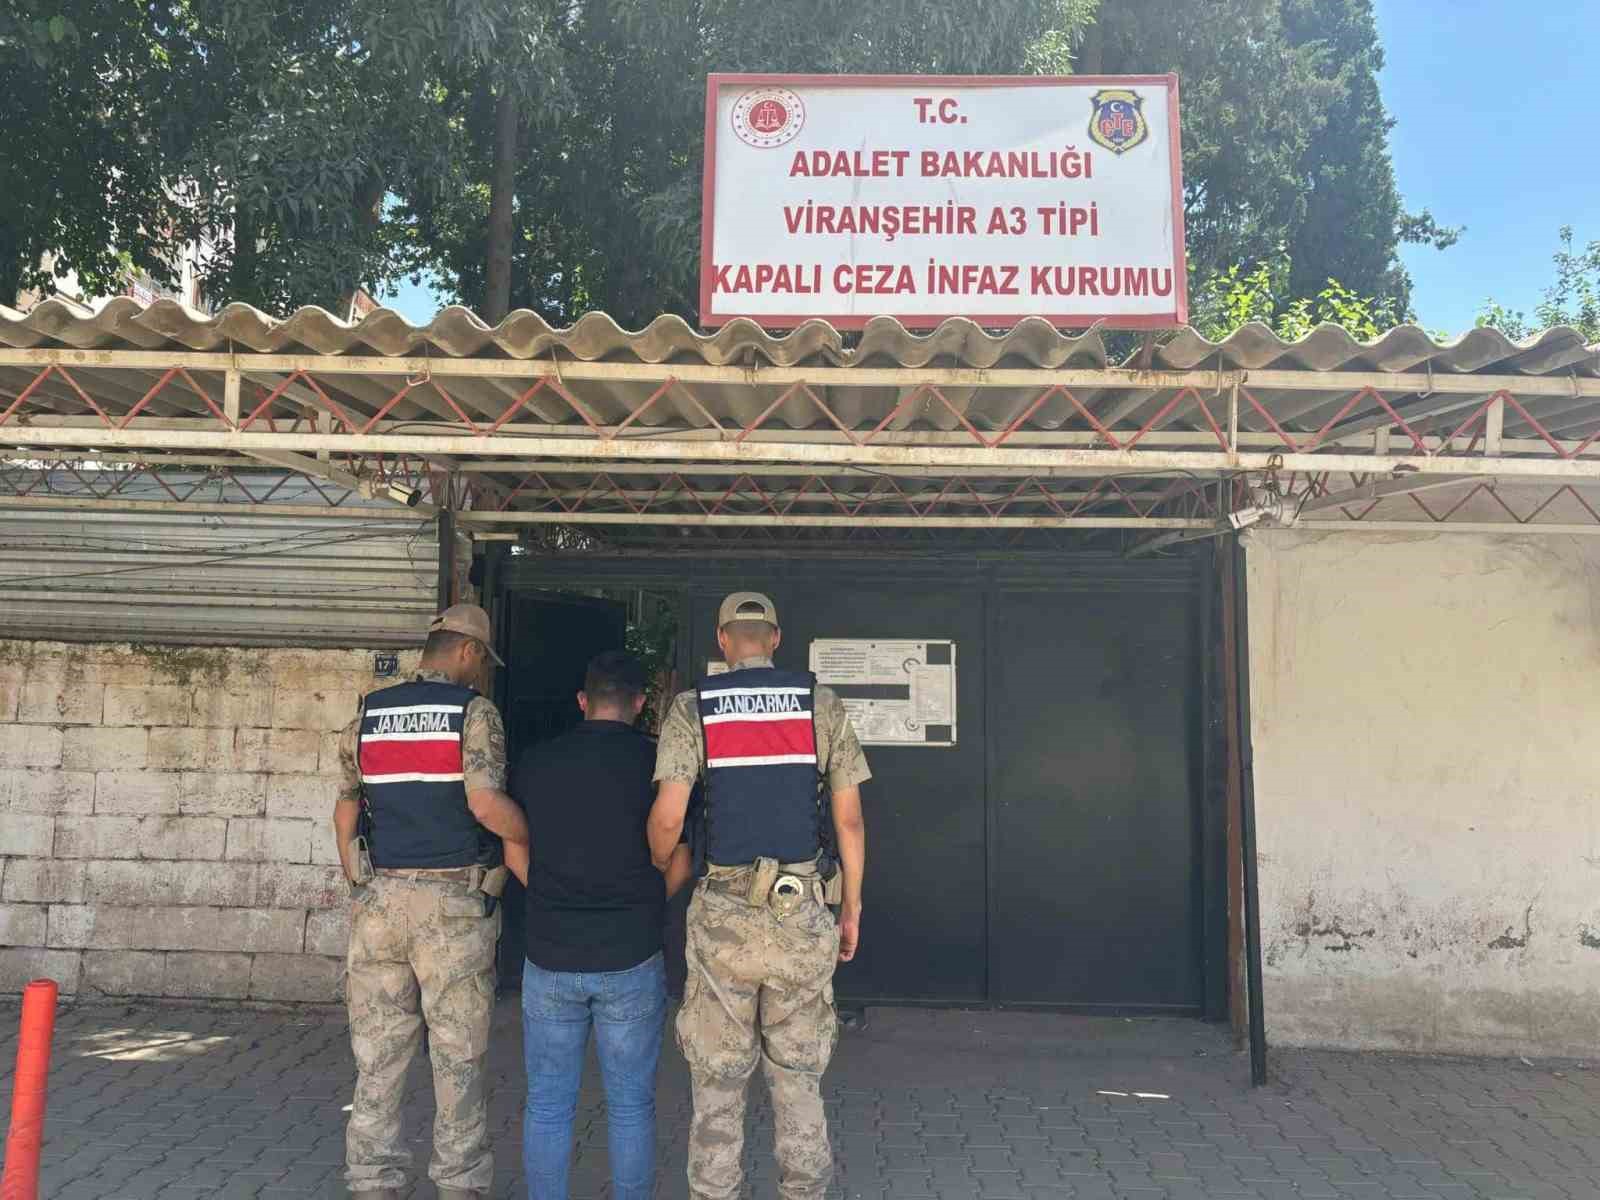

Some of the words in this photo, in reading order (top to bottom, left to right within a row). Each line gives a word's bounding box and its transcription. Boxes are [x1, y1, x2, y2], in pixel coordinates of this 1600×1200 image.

[914, 98, 967, 124] T.C.
[789, 151, 909, 177] ADALET
[922, 145, 1092, 178] BAKANLIĞI
[784, 200, 976, 242] VİRANŞEHİR
[987, 206, 1027, 235] A3
[1037, 200, 1099, 235] TİPİ
[712, 265, 821, 293] KAPALI
[833, 265, 915, 294] CEZA
[928, 258, 1019, 294] İNFAZ
[1031, 267, 1172, 296] KURUMU
[714, 694, 801, 714] JANDARMA
[373, 712, 450, 734] JANDARMA
